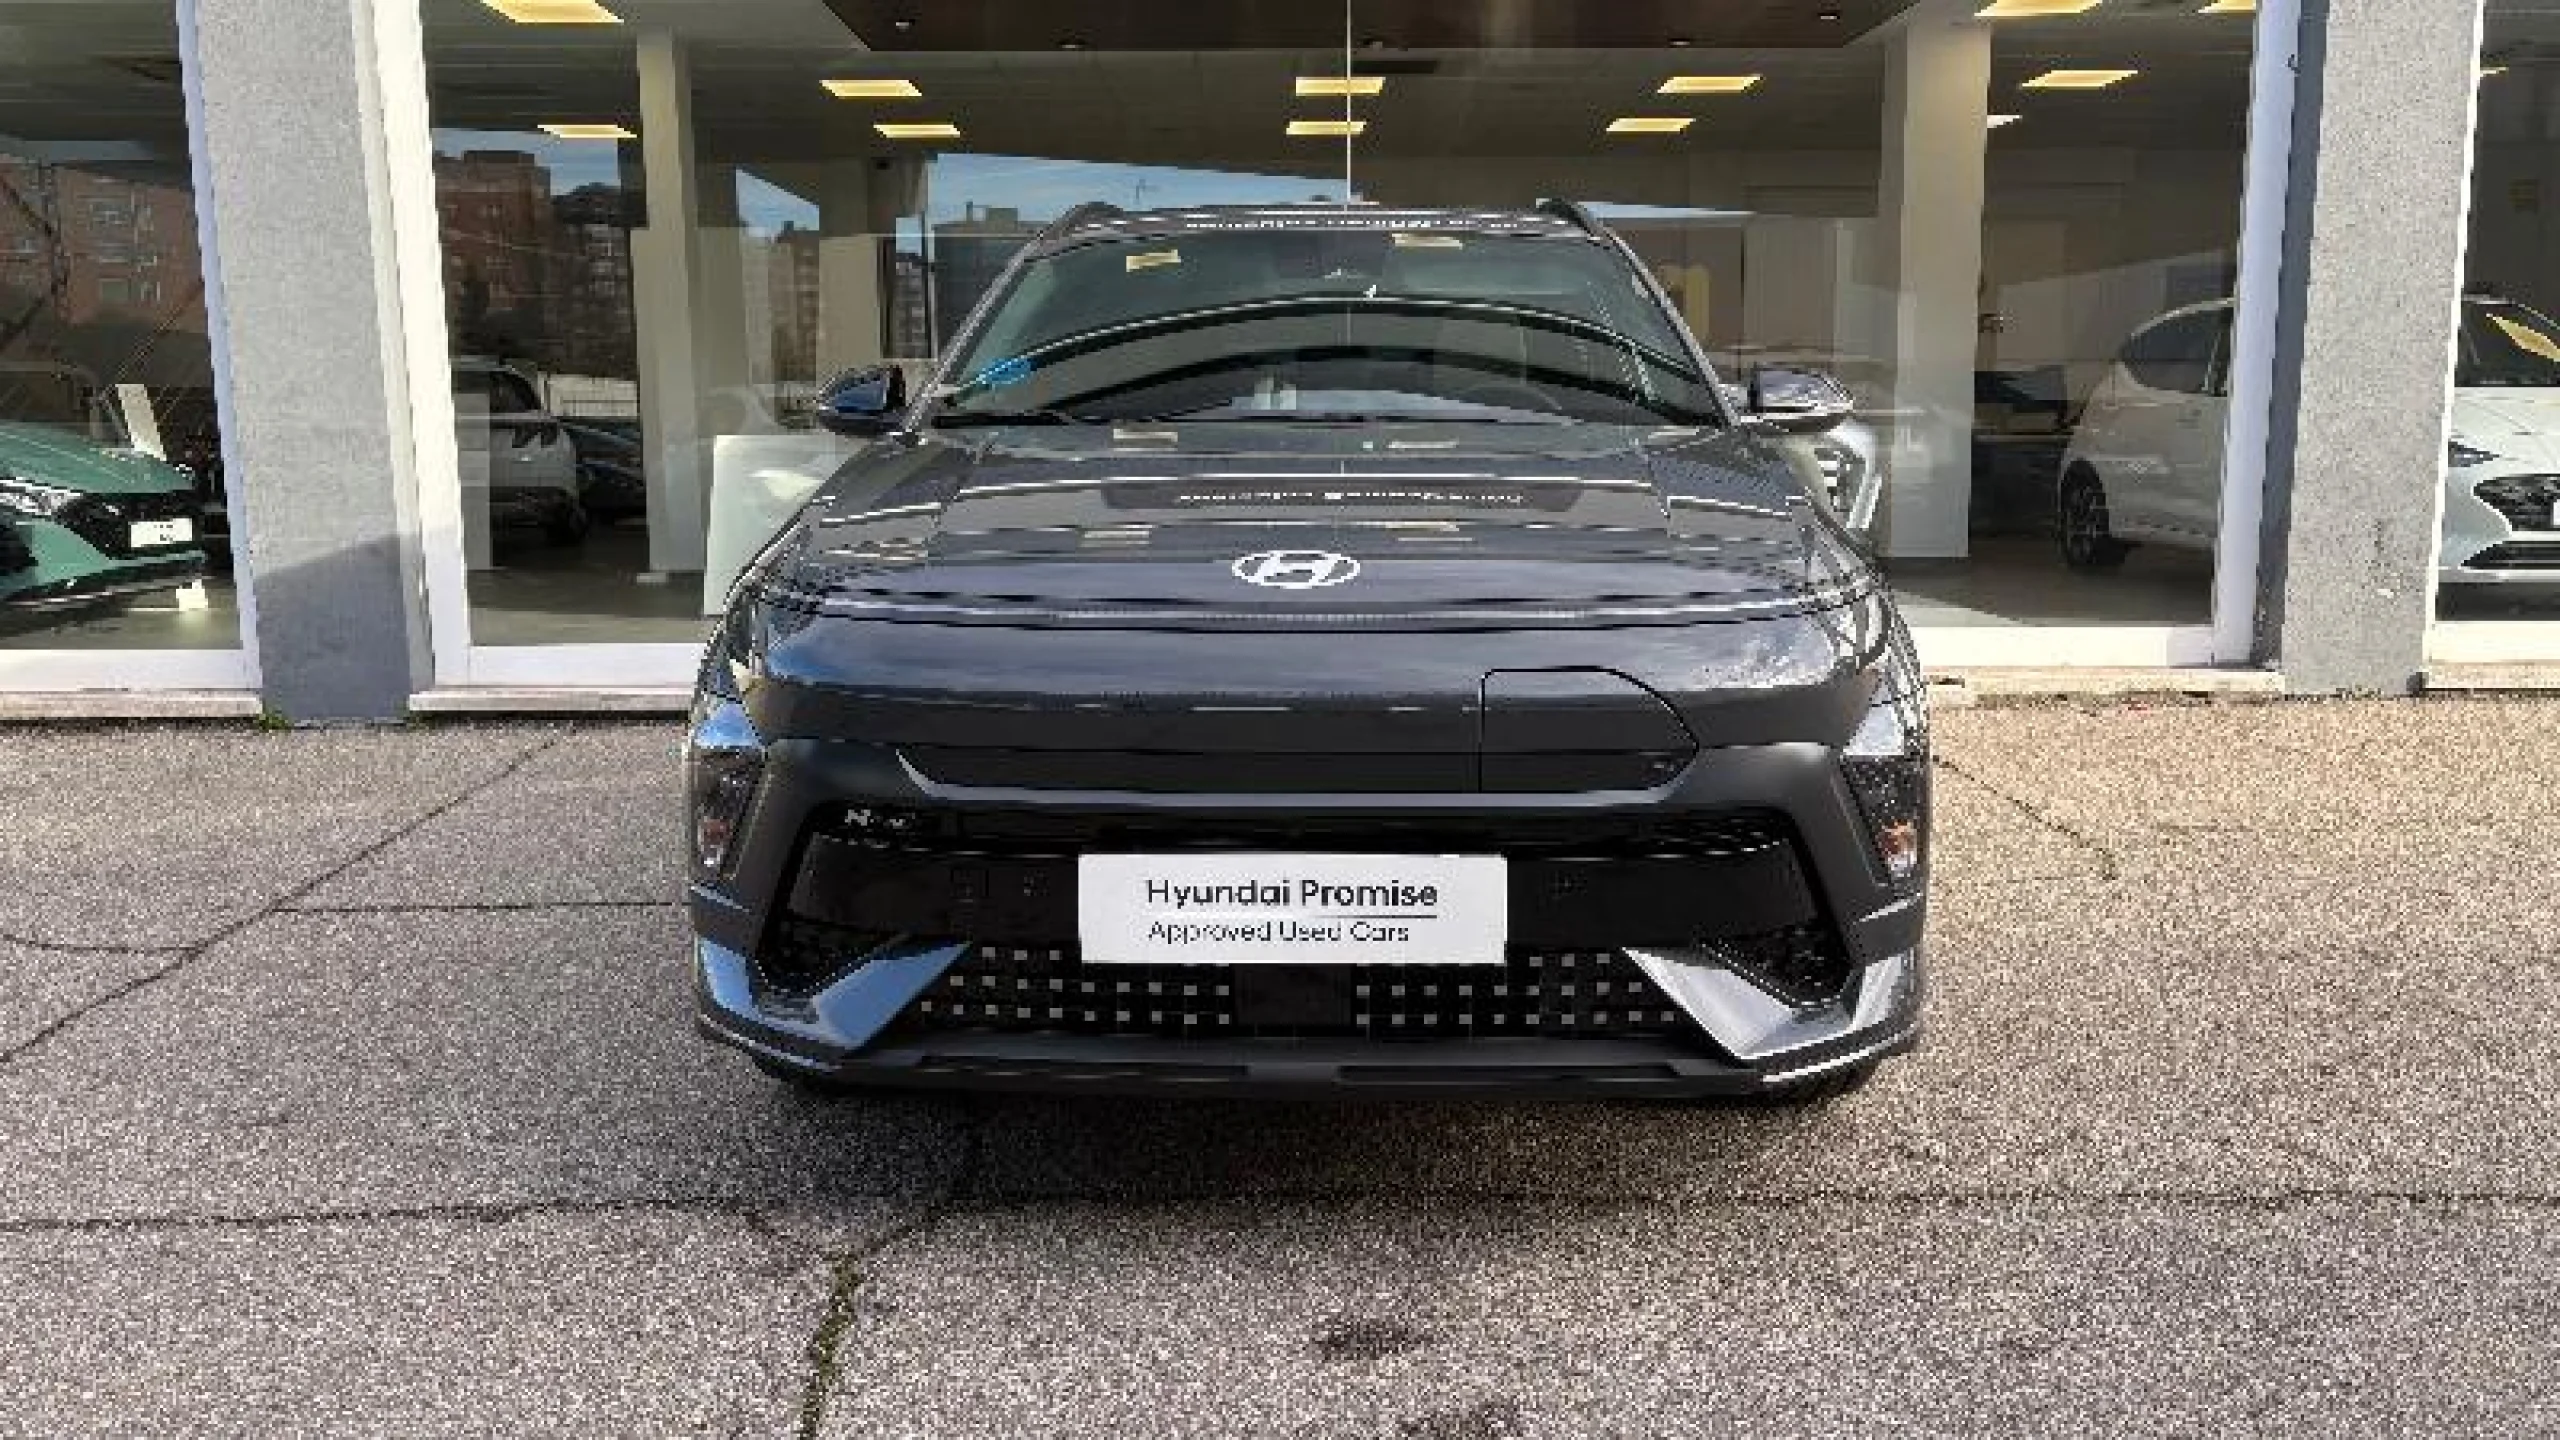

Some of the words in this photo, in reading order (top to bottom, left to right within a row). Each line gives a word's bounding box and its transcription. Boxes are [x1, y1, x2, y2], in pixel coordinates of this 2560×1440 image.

[1146, 879, 1291, 910] Hyundai
[1299, 879, 1438, 907] Promise
[1148, 920, 1272, 945] Approved
[1279, 920, 1342, 942] Used
[1349, 920, 1409, 942] Cars
